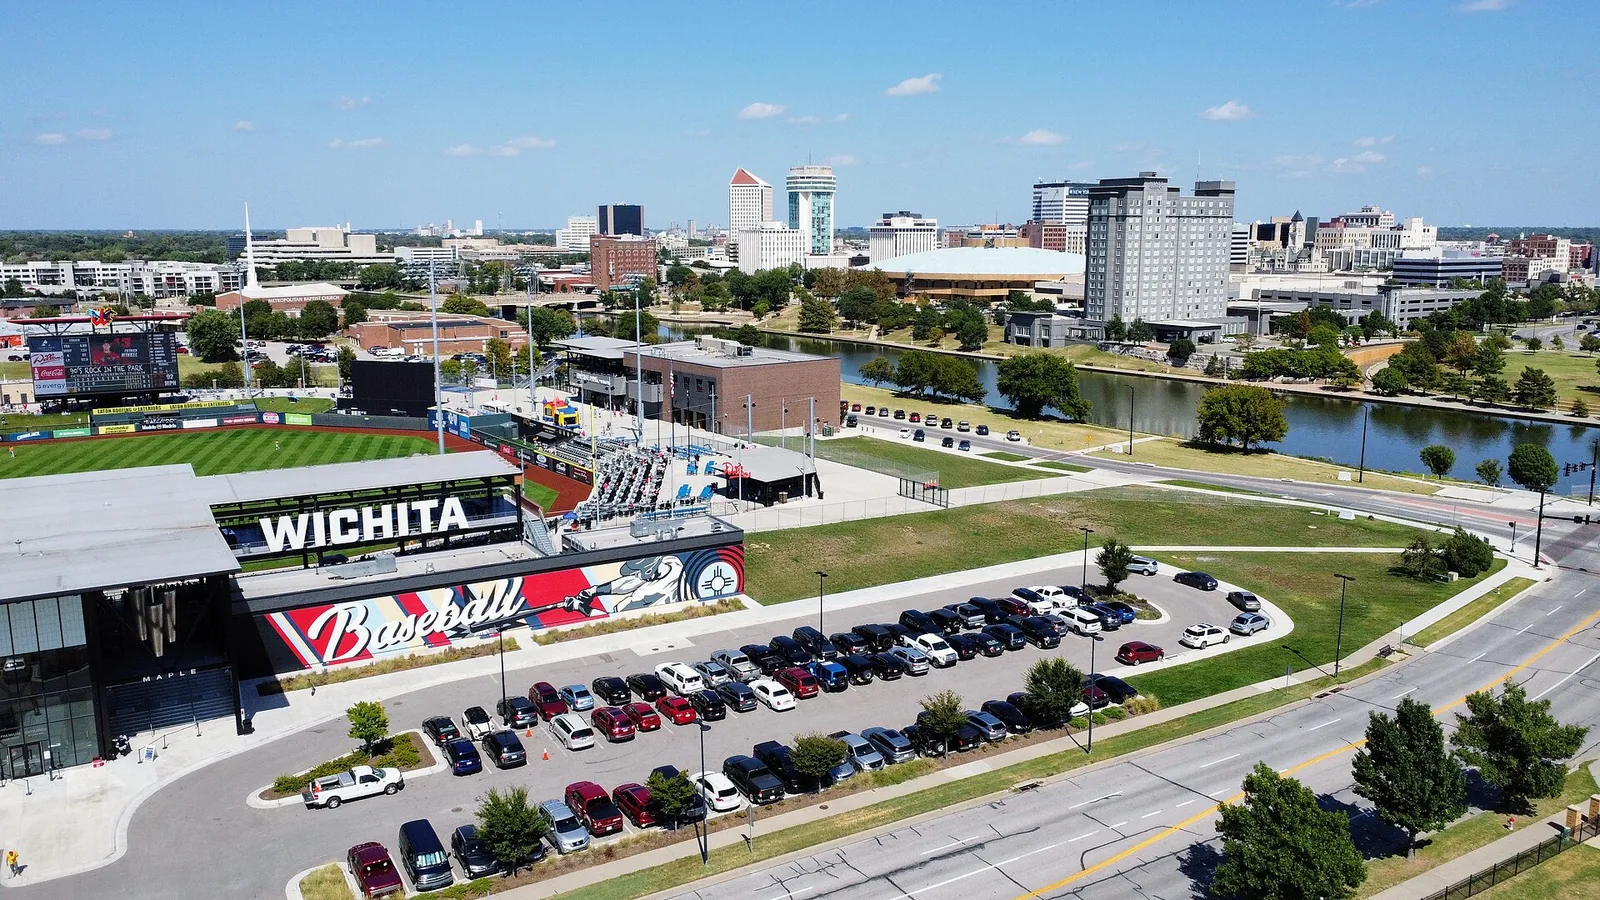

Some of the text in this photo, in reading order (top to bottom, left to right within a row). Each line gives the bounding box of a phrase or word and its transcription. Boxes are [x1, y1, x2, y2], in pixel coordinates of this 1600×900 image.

[258, 496, 470, 552] WICHITA
[307, 576, 526, 662] Baseball
[142, 669, 196, 682] MAPLE
